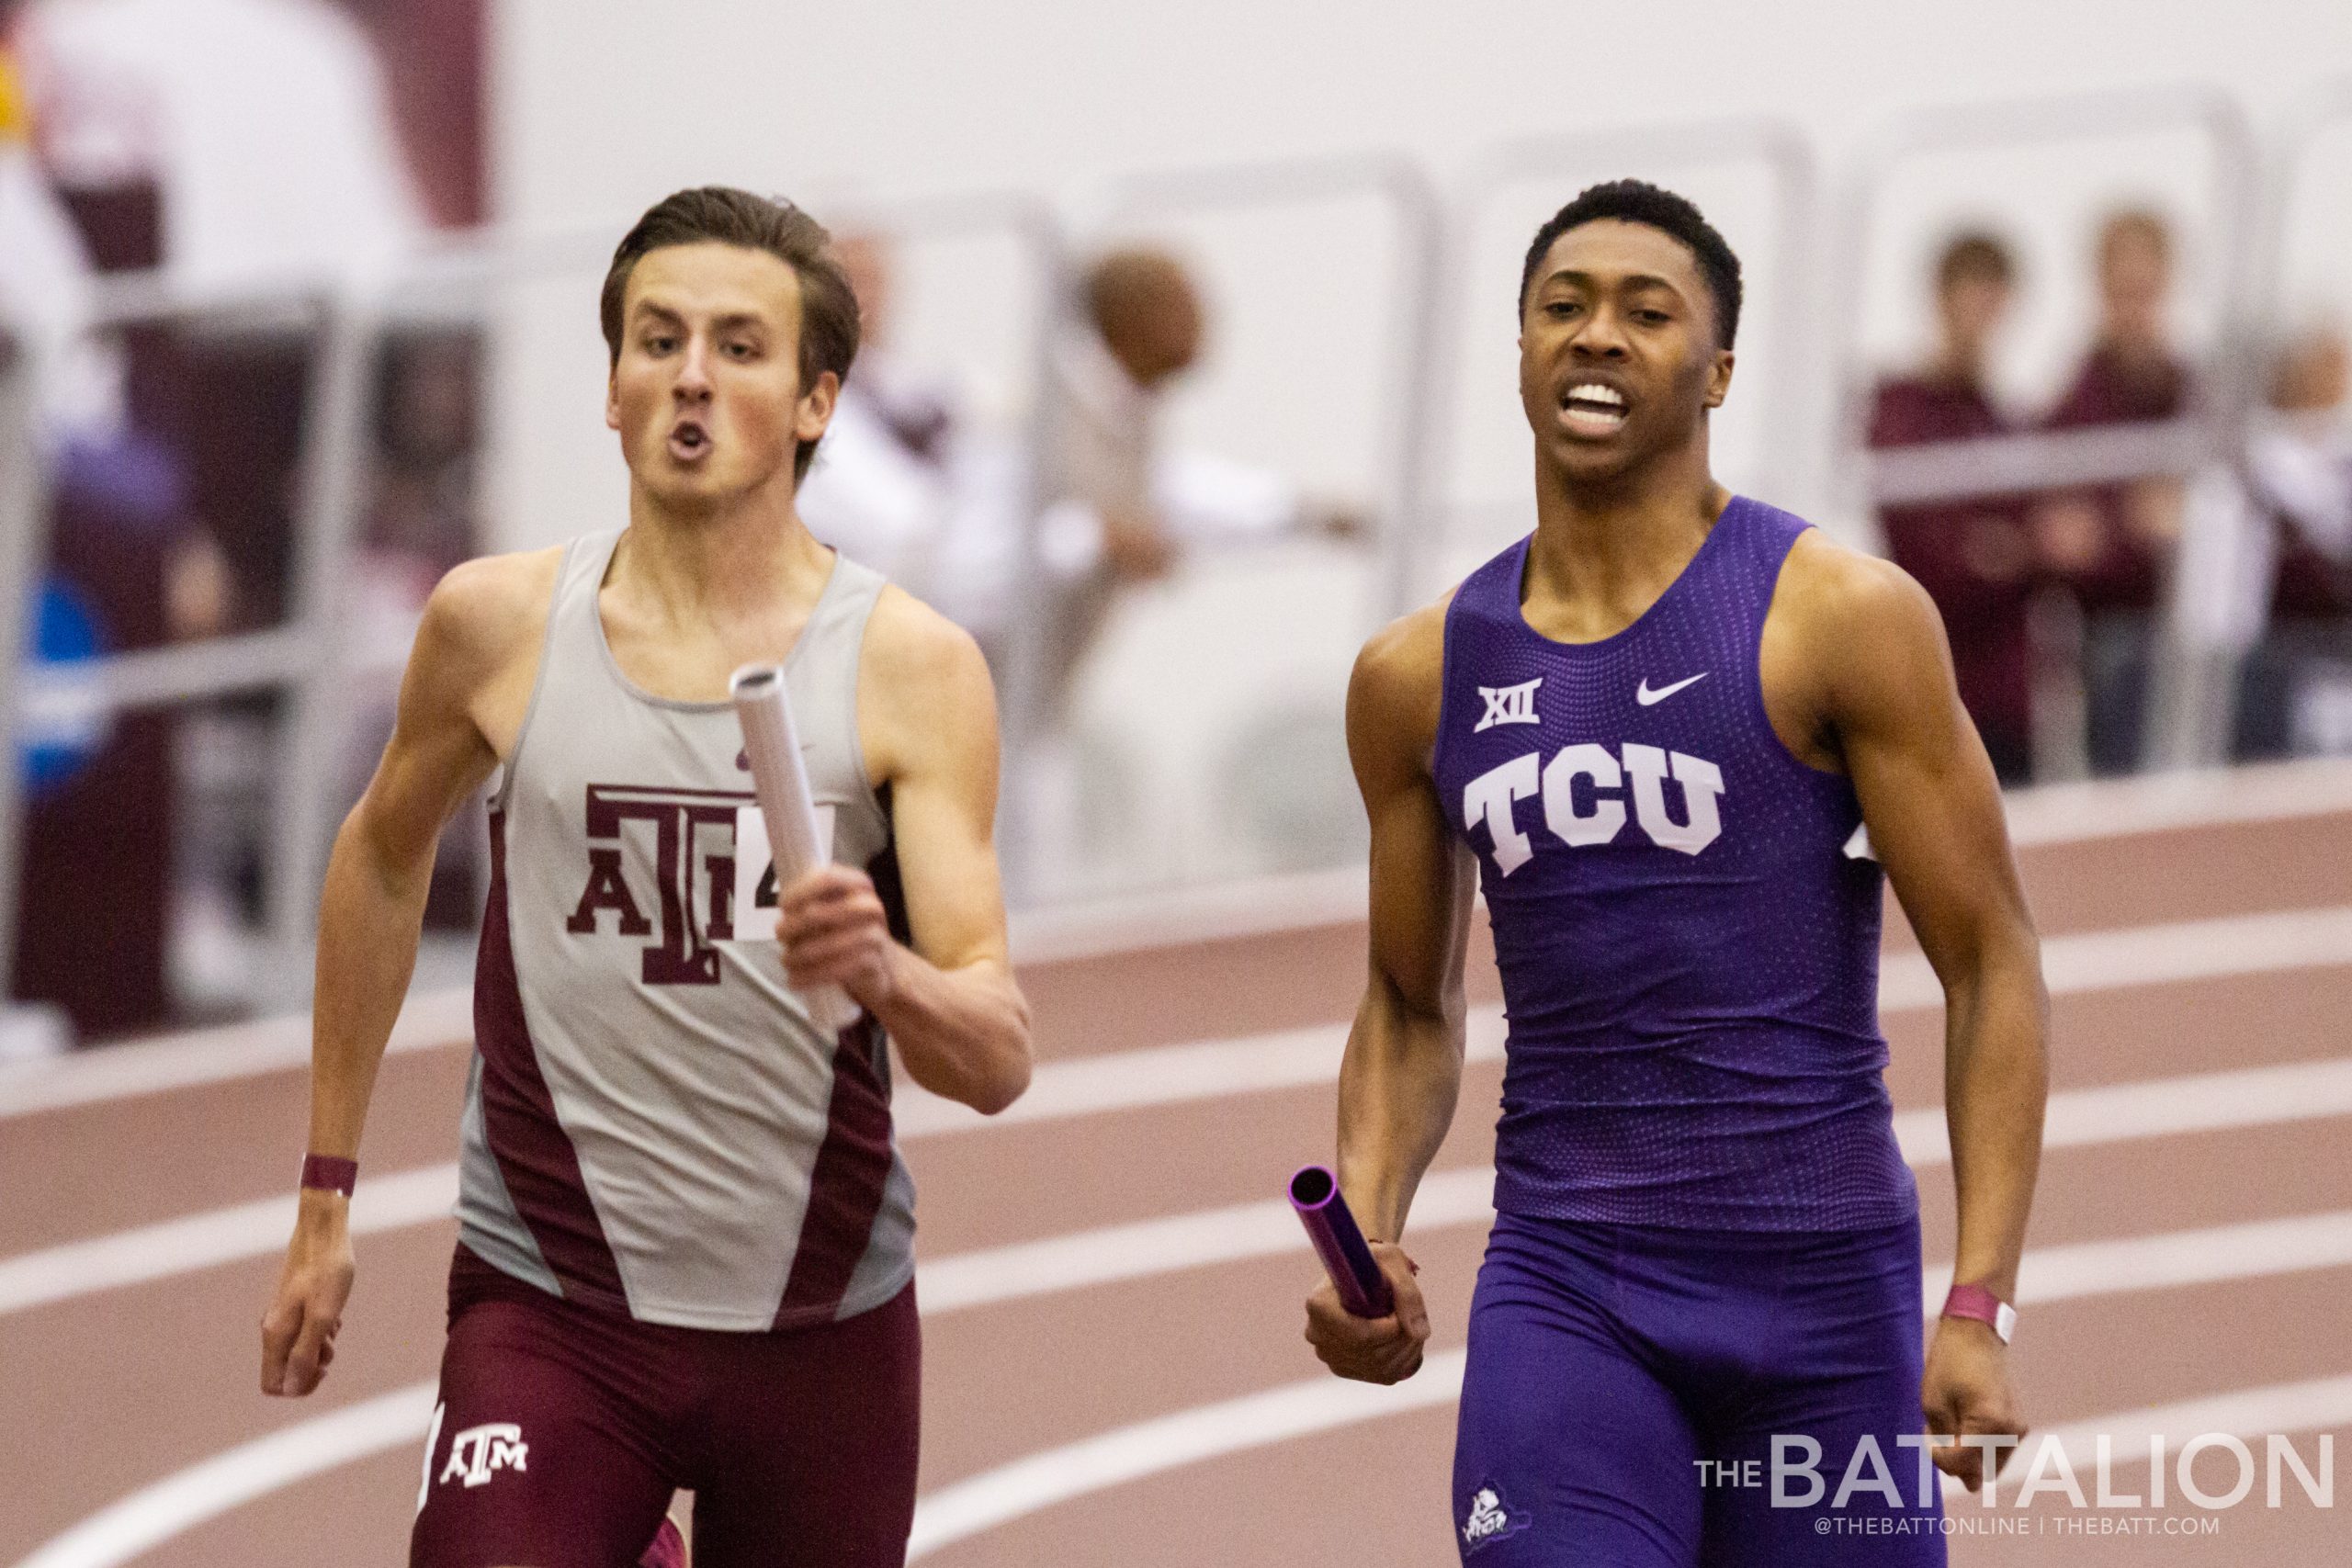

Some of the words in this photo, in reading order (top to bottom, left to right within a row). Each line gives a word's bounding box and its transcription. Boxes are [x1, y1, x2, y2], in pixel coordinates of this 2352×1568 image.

[1474, 677, 1544, 734] XII
[1464, 742, 1725, 878] TCU
[439, 1423, 529, 1488] ATM
